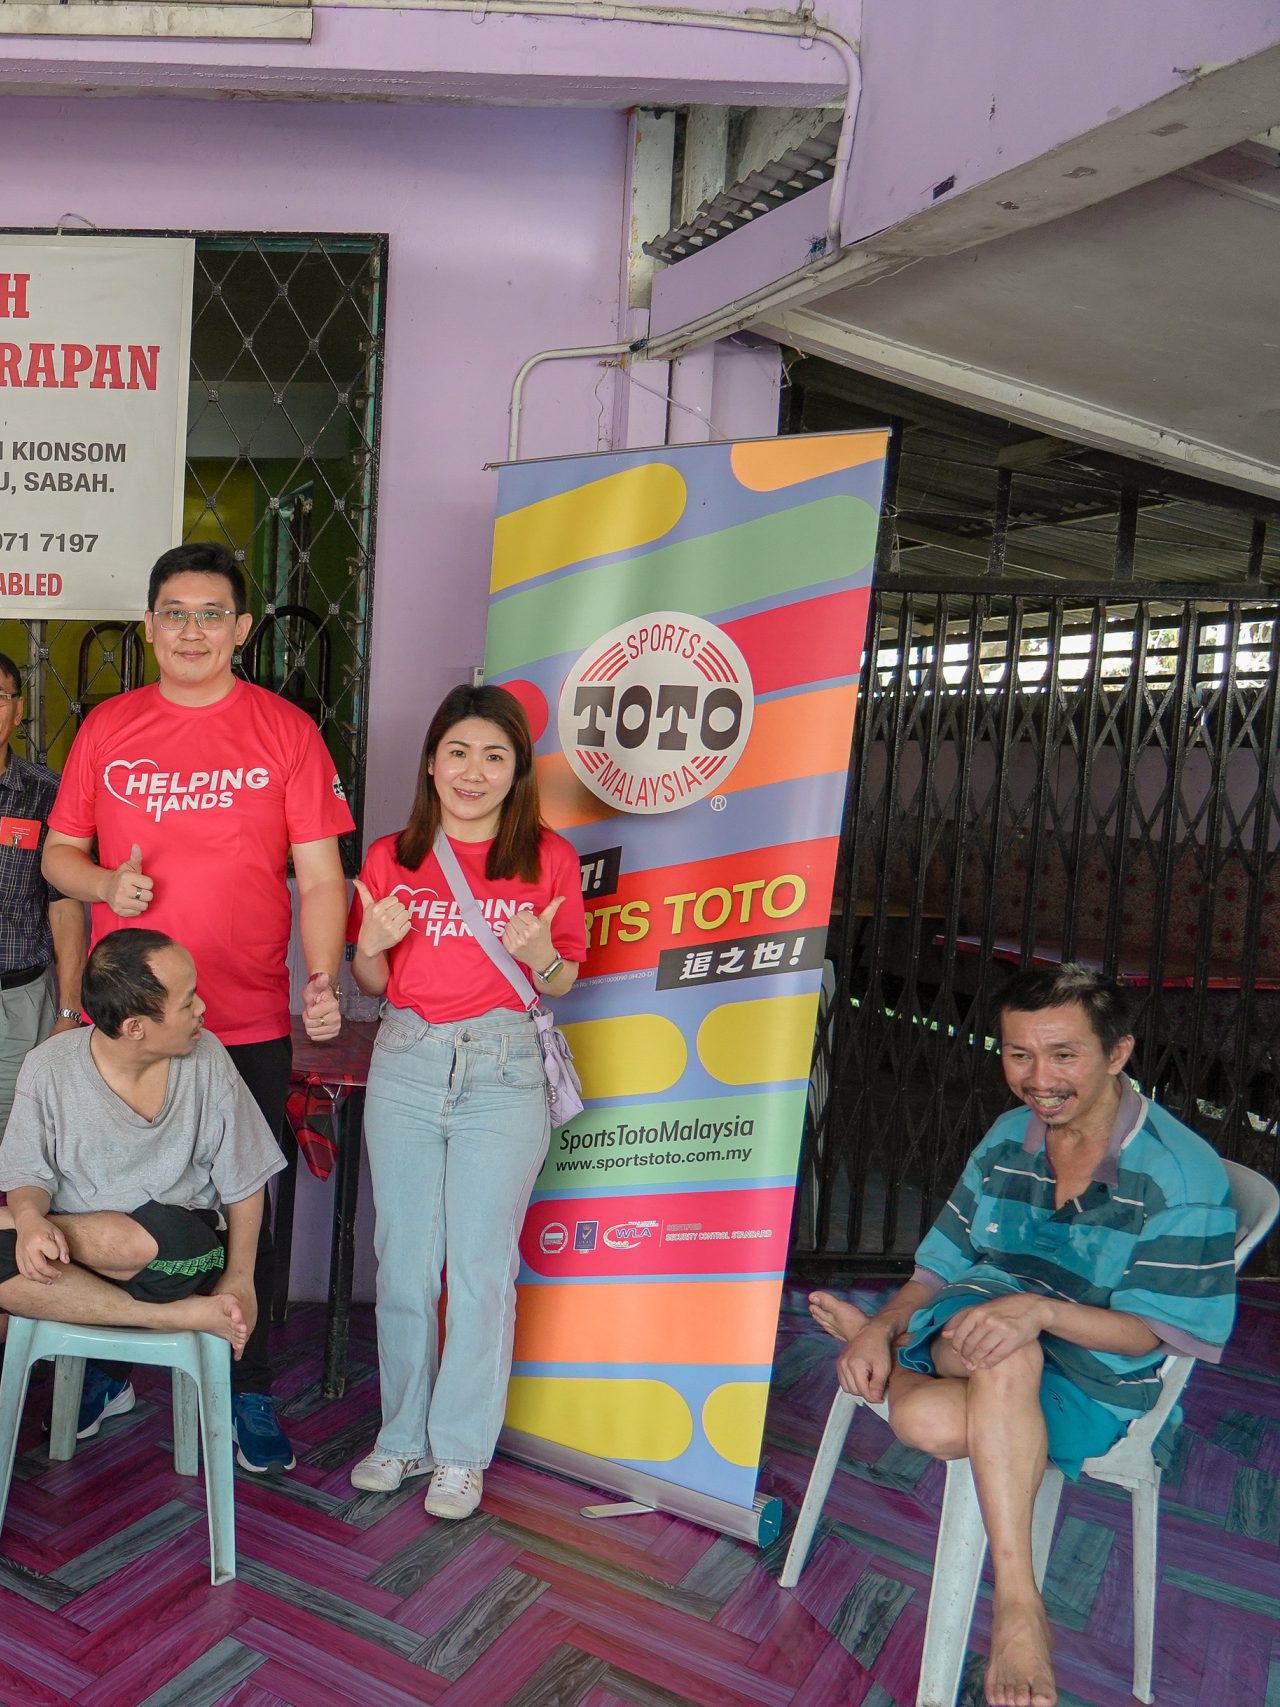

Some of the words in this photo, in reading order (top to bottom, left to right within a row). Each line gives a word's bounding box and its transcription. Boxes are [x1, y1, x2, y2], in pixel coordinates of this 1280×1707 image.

[12, 440, 127, 463] KIONSOM
[24, 471, 115, 493] SABAH.
[40, 532, 99, 554] 7197
[626, 623, 701, 659] SPORTS
[574, 684, 743, 751] TOTO
[125, 767, 270, 796] HELPING
[598, 764, 702, 807] MALAYSIA
[146, 791, 234, 822] HANDS
[664, 874, 806, 935] TOTO
[426, 920, 506, 946] HANS
[559, 1115, 754, 1154] SportsTotoMalaysia
[556, 1148, 752, 1172] www.sportstoto.com.my
[615, 1227, 652, 1239] WLA
